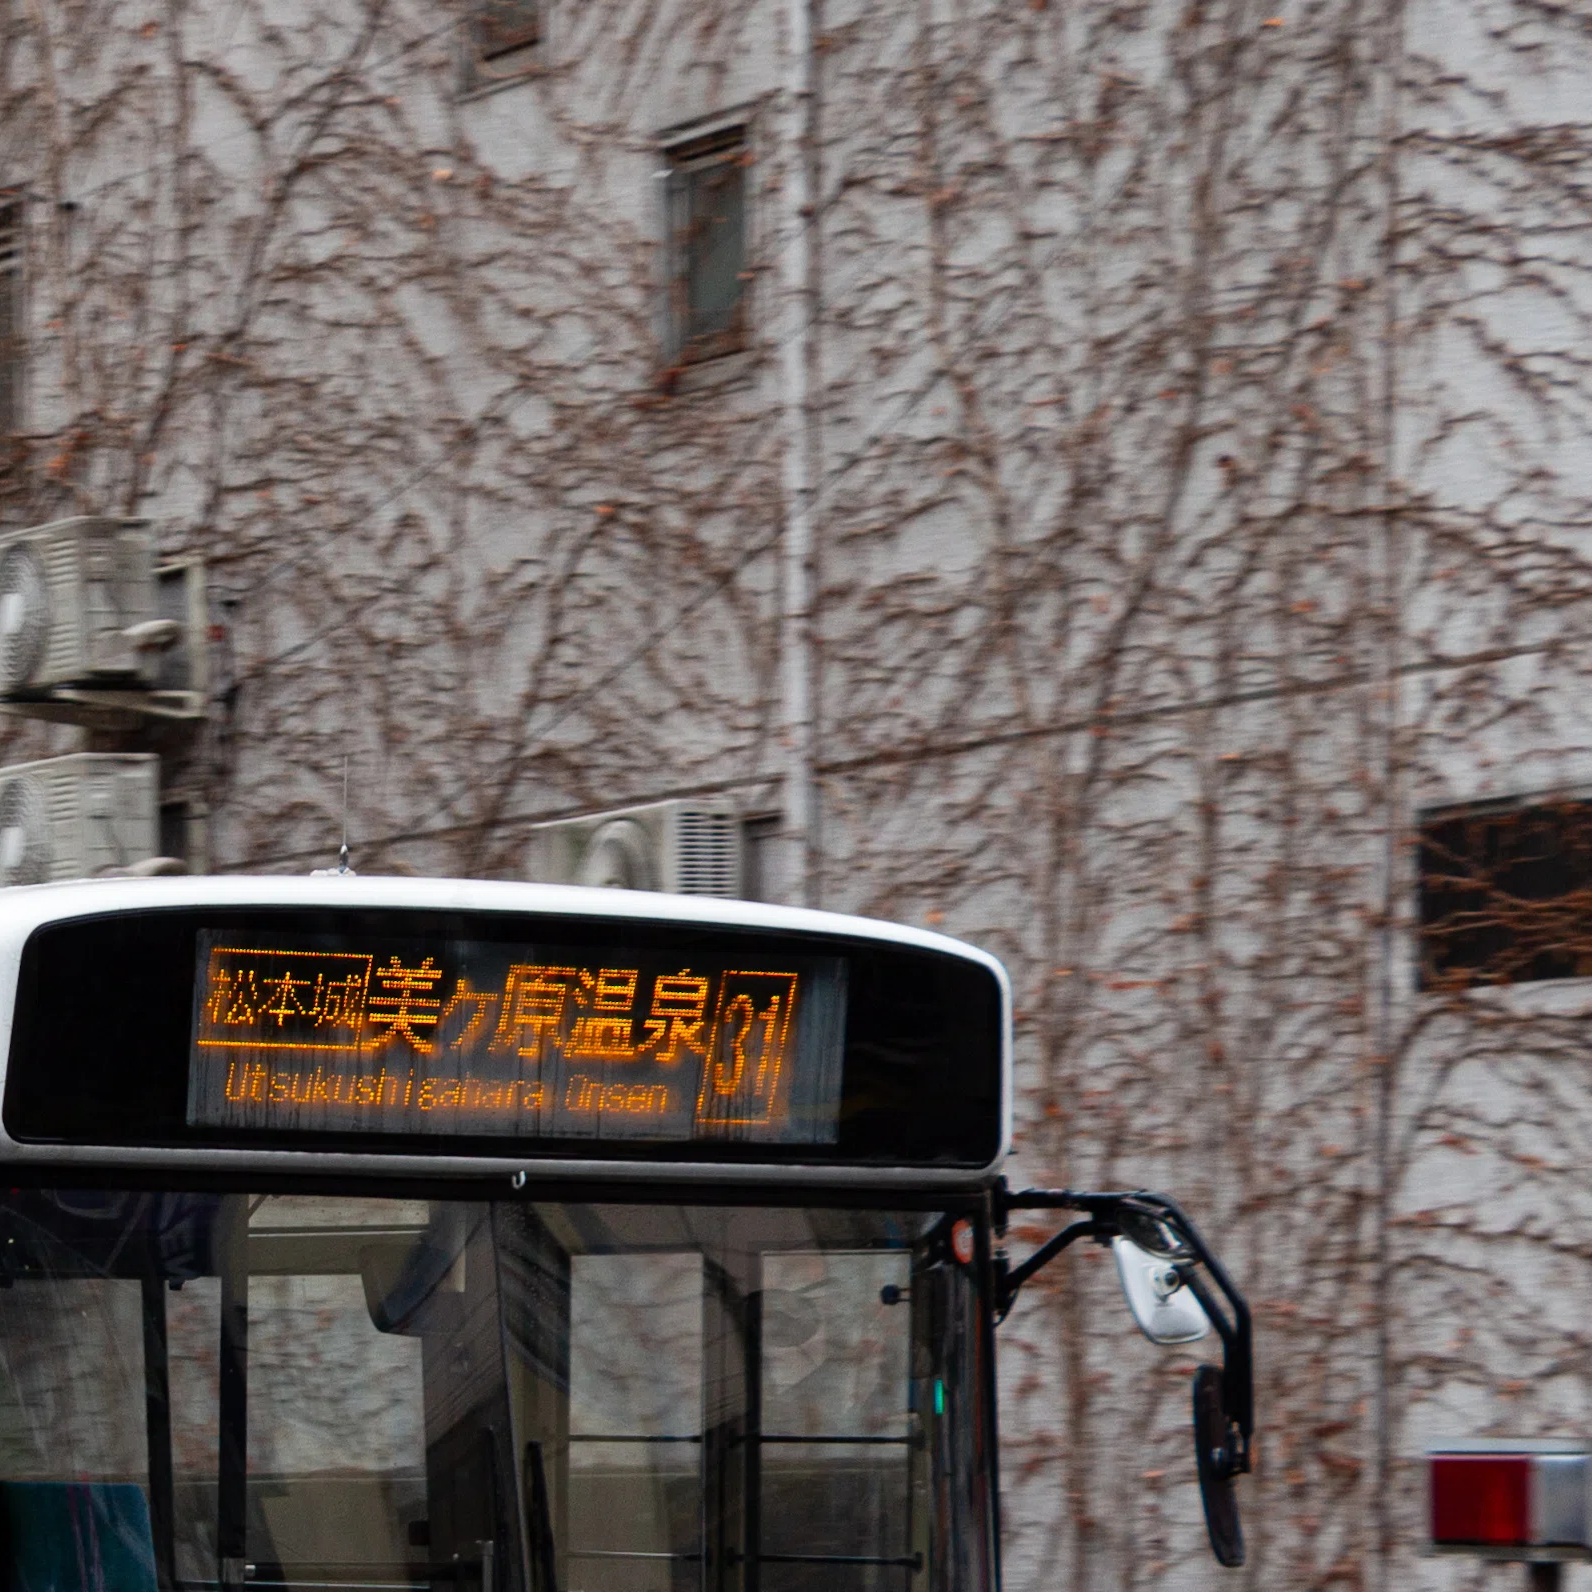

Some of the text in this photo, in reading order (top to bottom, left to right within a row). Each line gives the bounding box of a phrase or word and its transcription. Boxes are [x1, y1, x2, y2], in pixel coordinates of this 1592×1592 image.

[208, 968, 361, 1030] 松本城
[714, 993, 781, 1097] 31
[225, 1062, 669, 1114] Utsukushigahara Onsen
